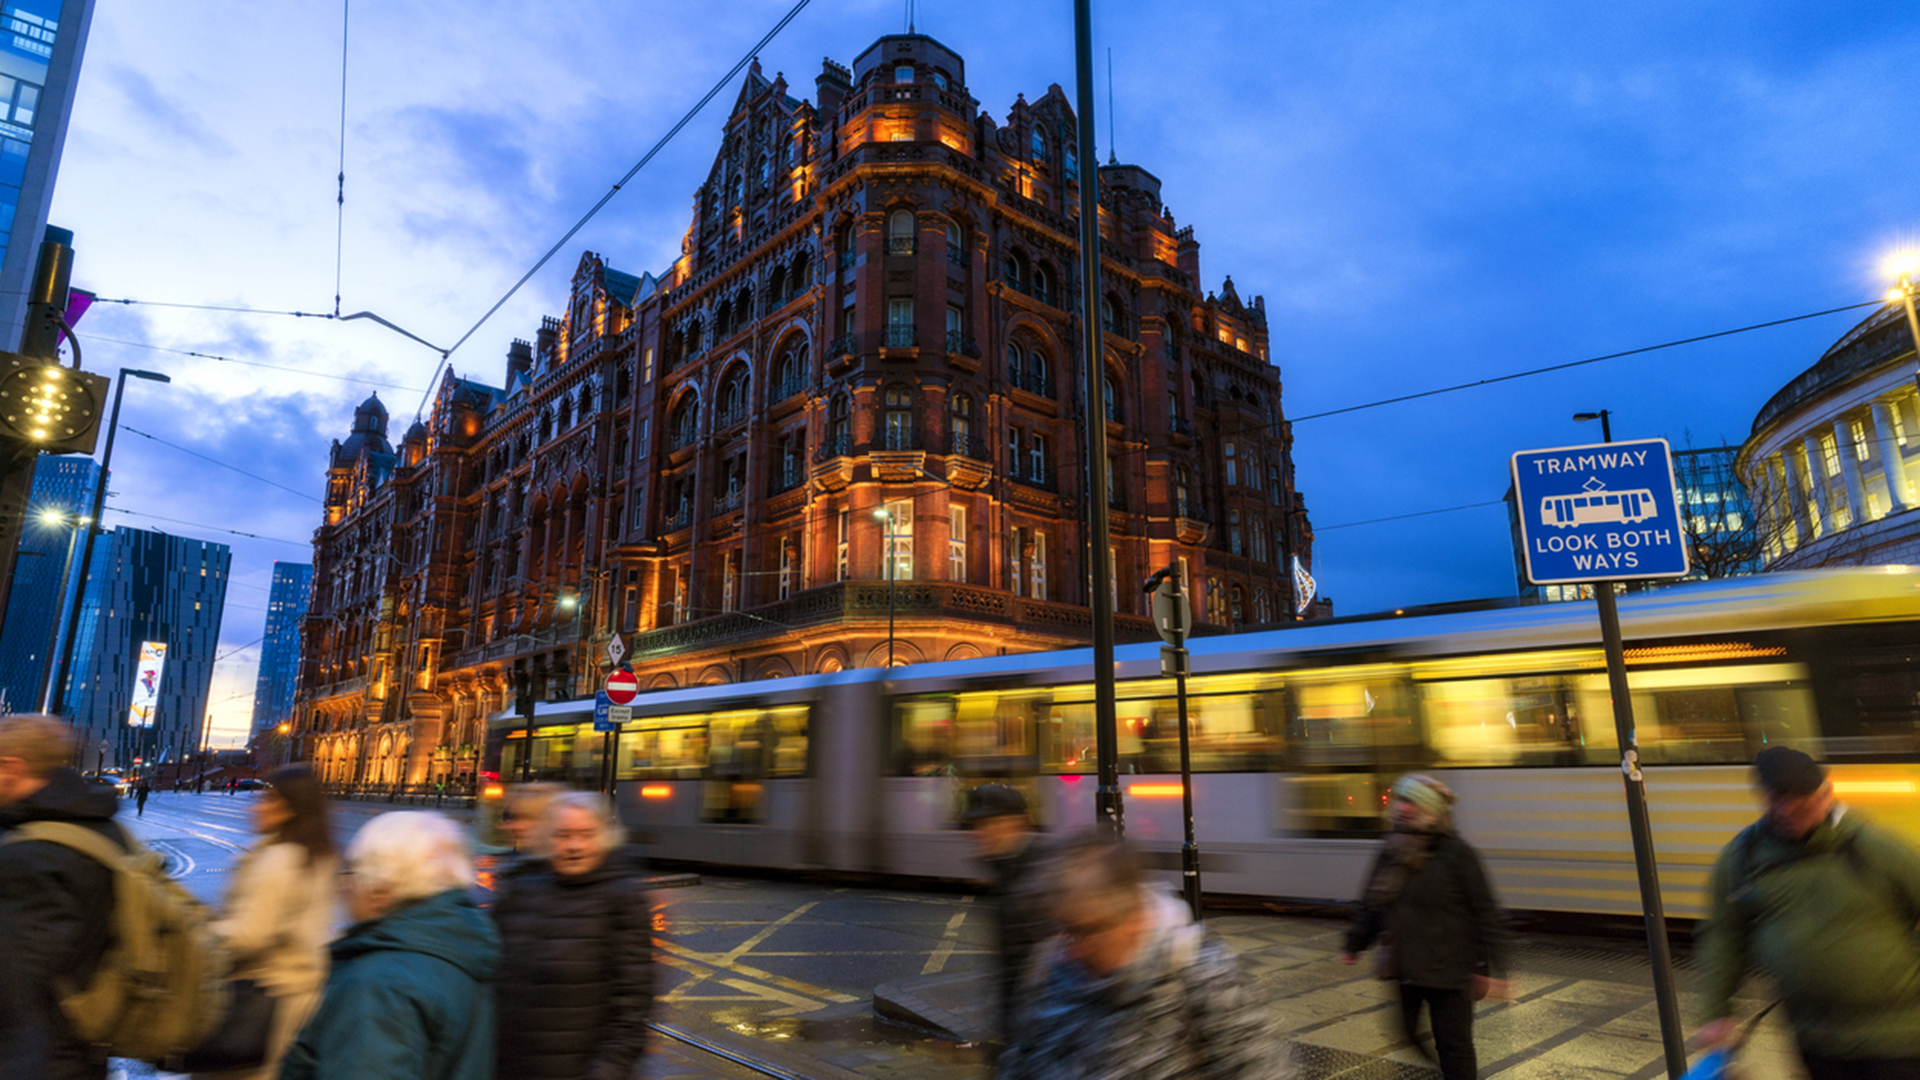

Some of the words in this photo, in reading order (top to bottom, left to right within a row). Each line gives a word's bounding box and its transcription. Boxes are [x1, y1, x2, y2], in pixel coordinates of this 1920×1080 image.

[1533, 450, 1647, 474] TRAMWAY
[1536, 533, 1598, 553] LOOK
[1606, 529, 1671, 549] BOTH
[1572, 551, 1639, 571] WAYS
[611, 644, 622, 654] 15
